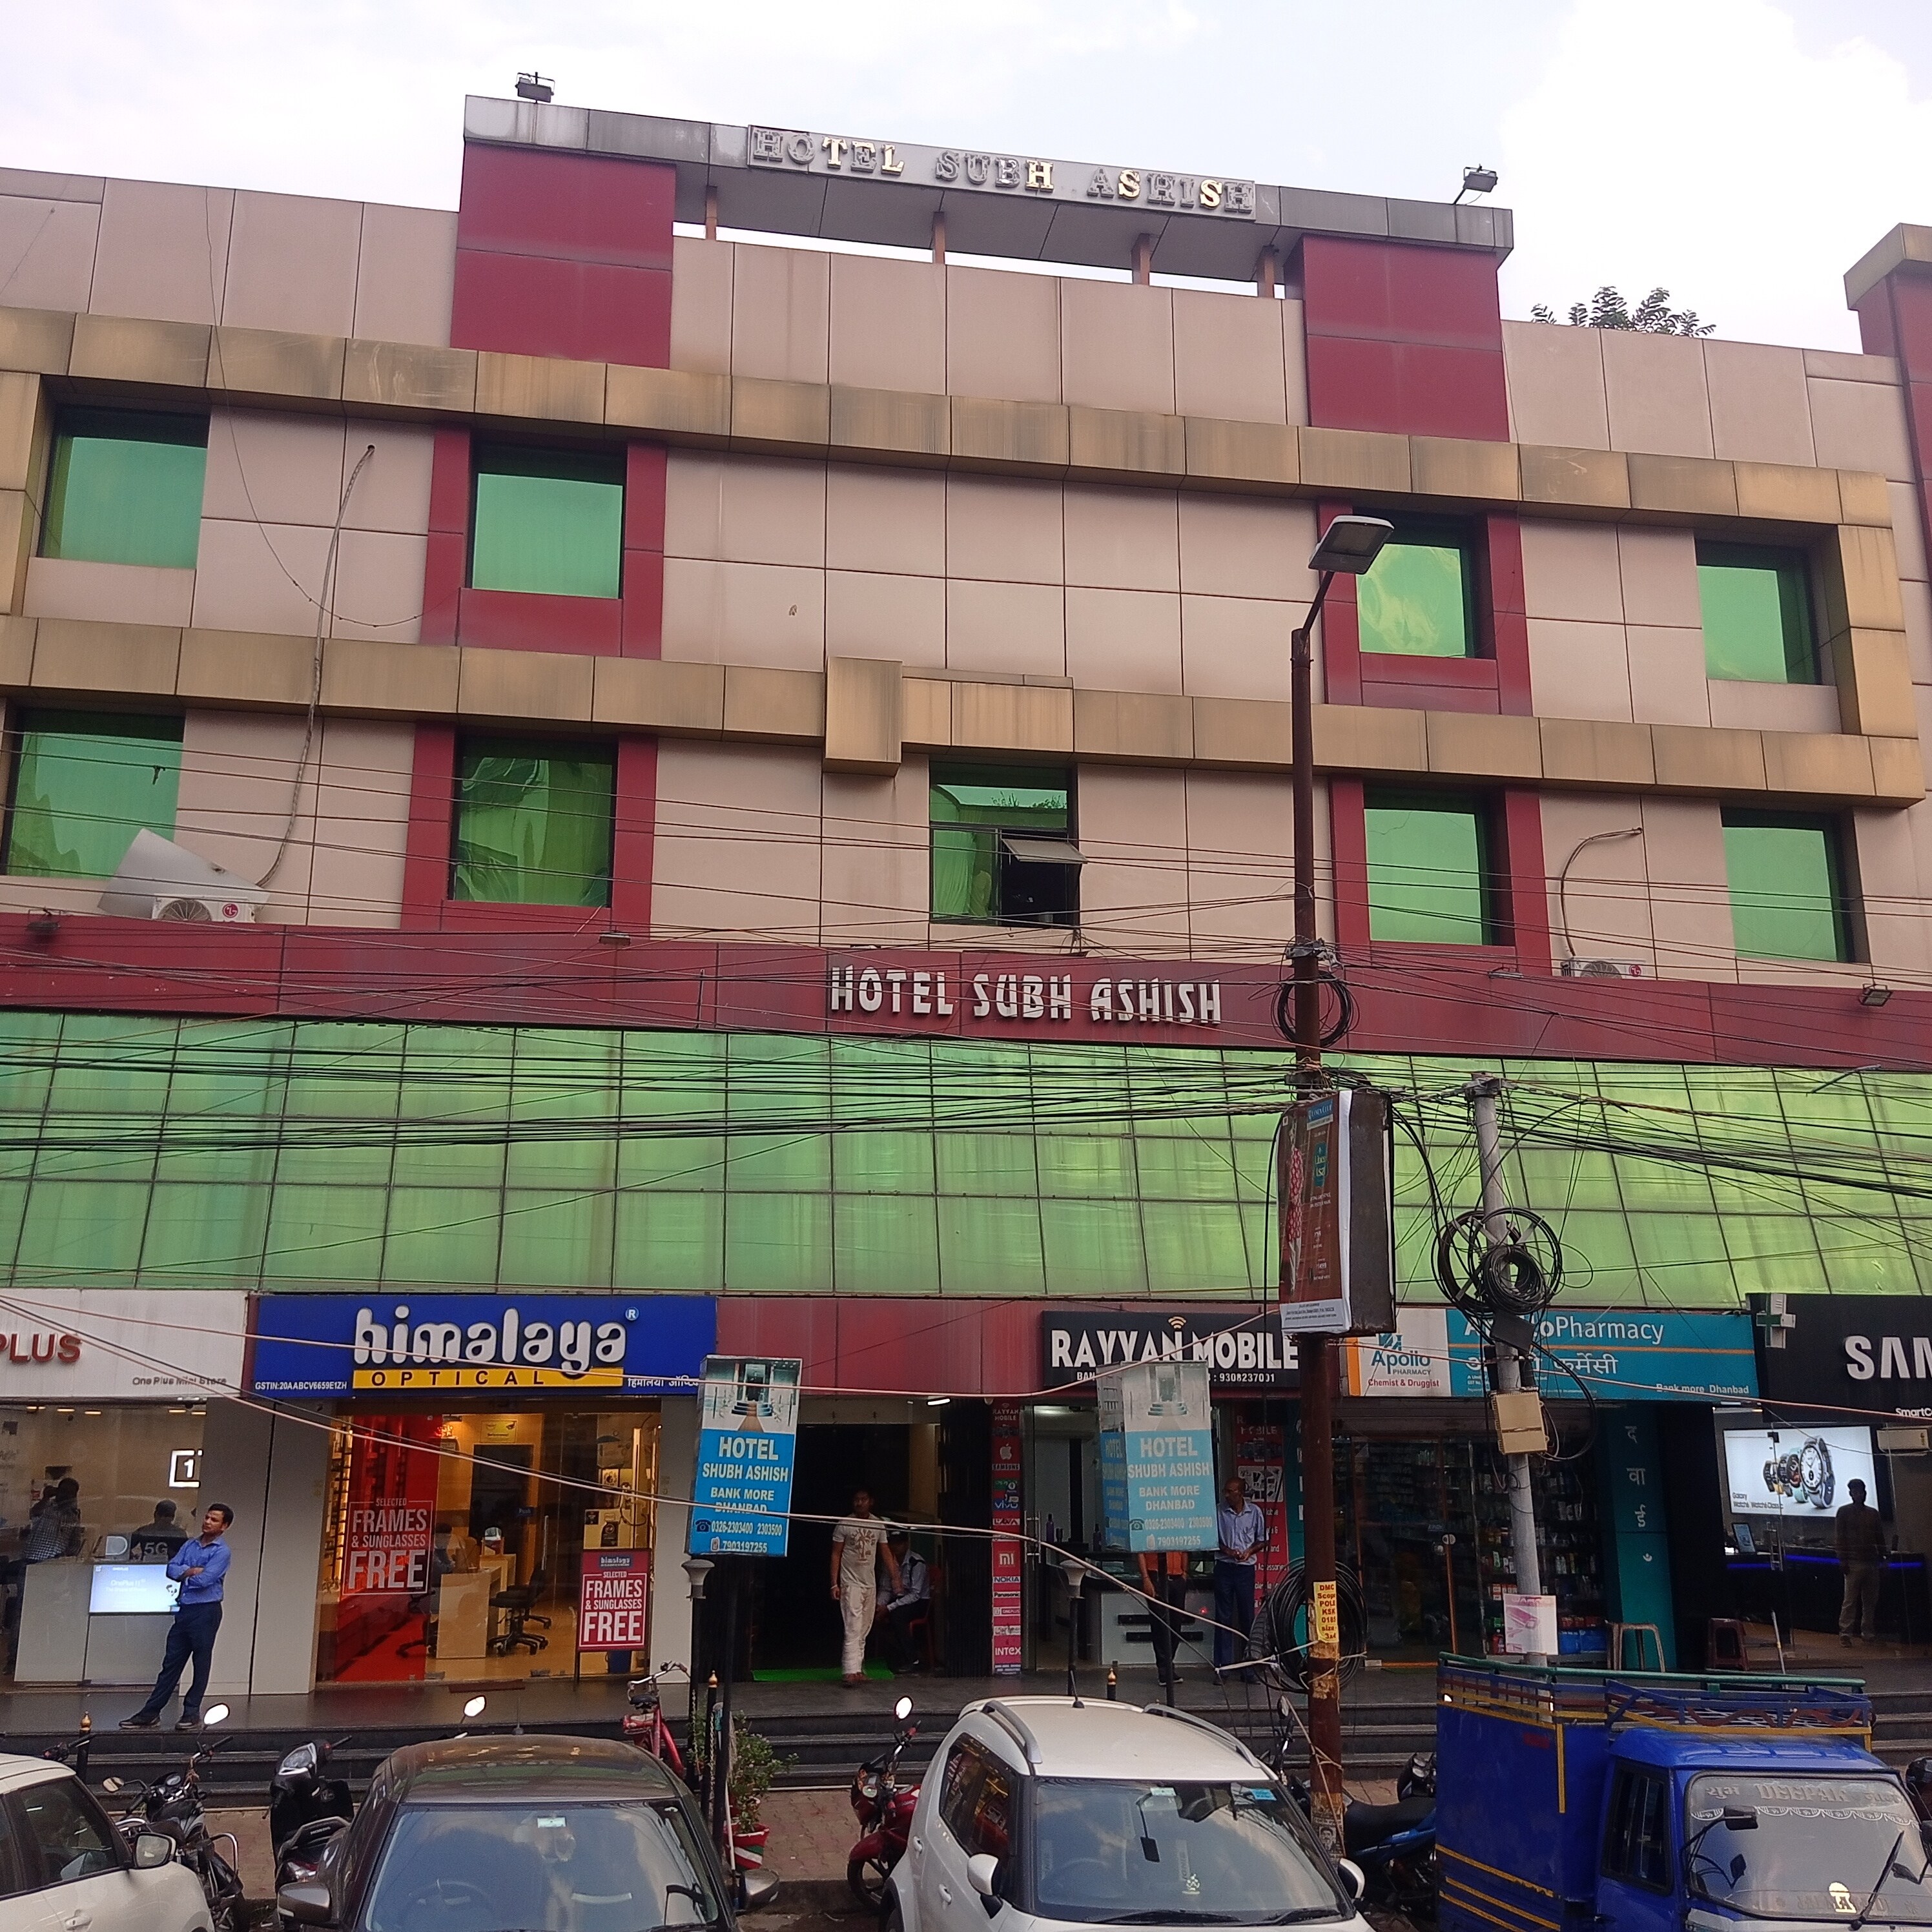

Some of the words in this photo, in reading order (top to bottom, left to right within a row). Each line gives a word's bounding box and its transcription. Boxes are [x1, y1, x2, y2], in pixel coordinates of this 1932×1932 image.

[752, 129, 905, 175] HOTEL
[936, 150, 1054, 192] SUBH
[1088, 167, 1254, 213] ASHISH
[830, 965, 953, 1014] HOTEL
[973, 973, 1072, 1020] SUBH
[1091, 978, 1221, 1024] ASHISH
[354, 1305, 627, 1376] himalaya
[1051, 1330, 1182, 1368] RAYYAN
[1193, 1331, 1299, 1370] MOBILE
[1371, 1350, 1430, 1374] Apollo
[132, 1376, 151, 1386] One
[154, 1376, 174, 1385] Plus
[371, 1368, 545, 1388] OPTICAL
[1076, 1372, 1096, 1381] BAN
[1368, 1378, 1399, 1386] Chemist
[1408, 1379, 1439, 1388] Druggist
[1709, 1384, 1749, 1393] Dhanbad
[718, 1436, 779, 1461] HOTEL
[1140, 1437, 1198, 1457] HOTEL
[702, 1463, 743, 1479] SHUBH
[745, 1465, 789, 1482] ASHISH
[1127, 1464, 1166, 1479] SHUBH
[1169, 1462, 1209, 1477] ASHISH
[711, 1486, 741, 1499] BANK
[744, 1488, 774, 1501] MORE
[1139, 1486, 1167, 1497] BANK
[1171, 1485, 1200, 1495] MORE
[376, 1498, 407, 1506] SELECTED
[1146, 1499, 1195, 1510] DHANBAD
[353, 1508, 427, 1532] FRAMES
[351, 1535, 359, 1548] &
[362, 1534, 426, 1548] SUNGLASSES
[348, 1550, 426, 1589] FREE
[586, 1579, 642, 1598] FRAMES
[584, 1599, 591, 1610] &
[593, 1599, 642, 1610] SUNGLASSES
[583, 1610, 642, 1642] FREE
